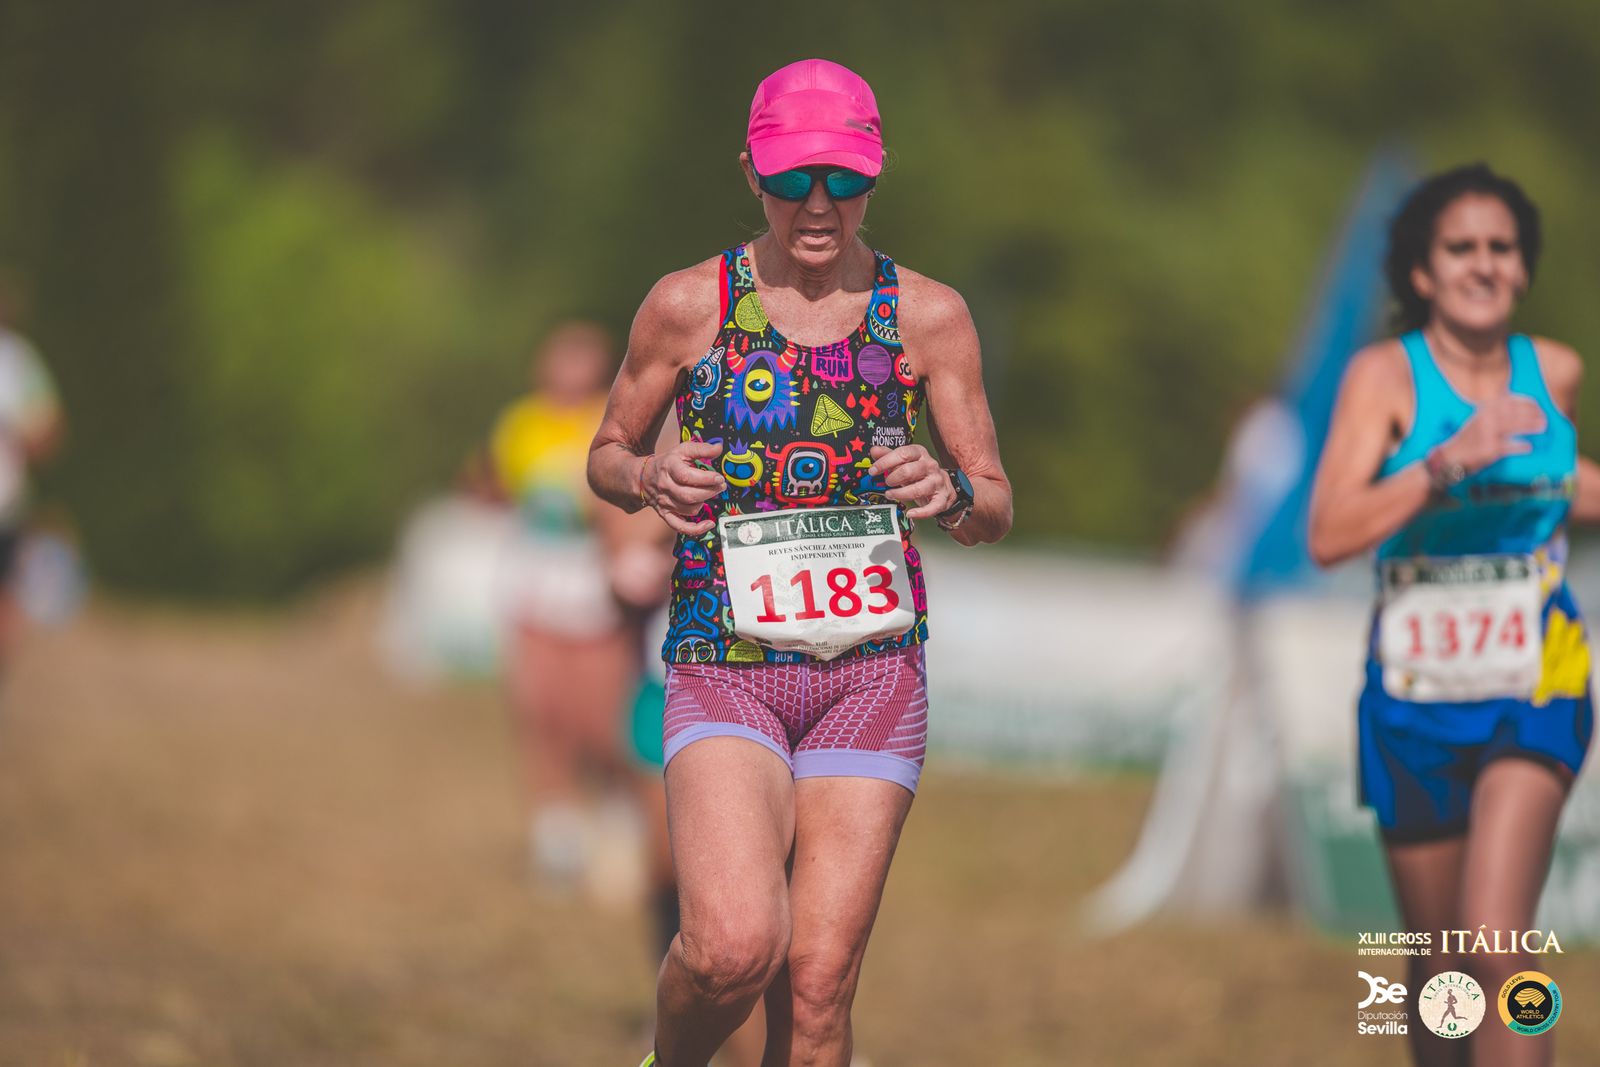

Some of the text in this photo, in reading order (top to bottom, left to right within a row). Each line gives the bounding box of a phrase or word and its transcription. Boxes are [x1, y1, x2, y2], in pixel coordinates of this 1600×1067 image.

[815, 358, 848, 377] RUN
[872, 435, 906, 446] MONSTER
[775, 513, 853, 537] ITÁLICA
[768, 541, 865, 556] REYES SÁNCHEZ AMENEIRO
[790, 551, 846, 561] INDEPENDIENTE
[750, 565, 900, 623] 1183
[1406, 606, 1526, 658] 1374
